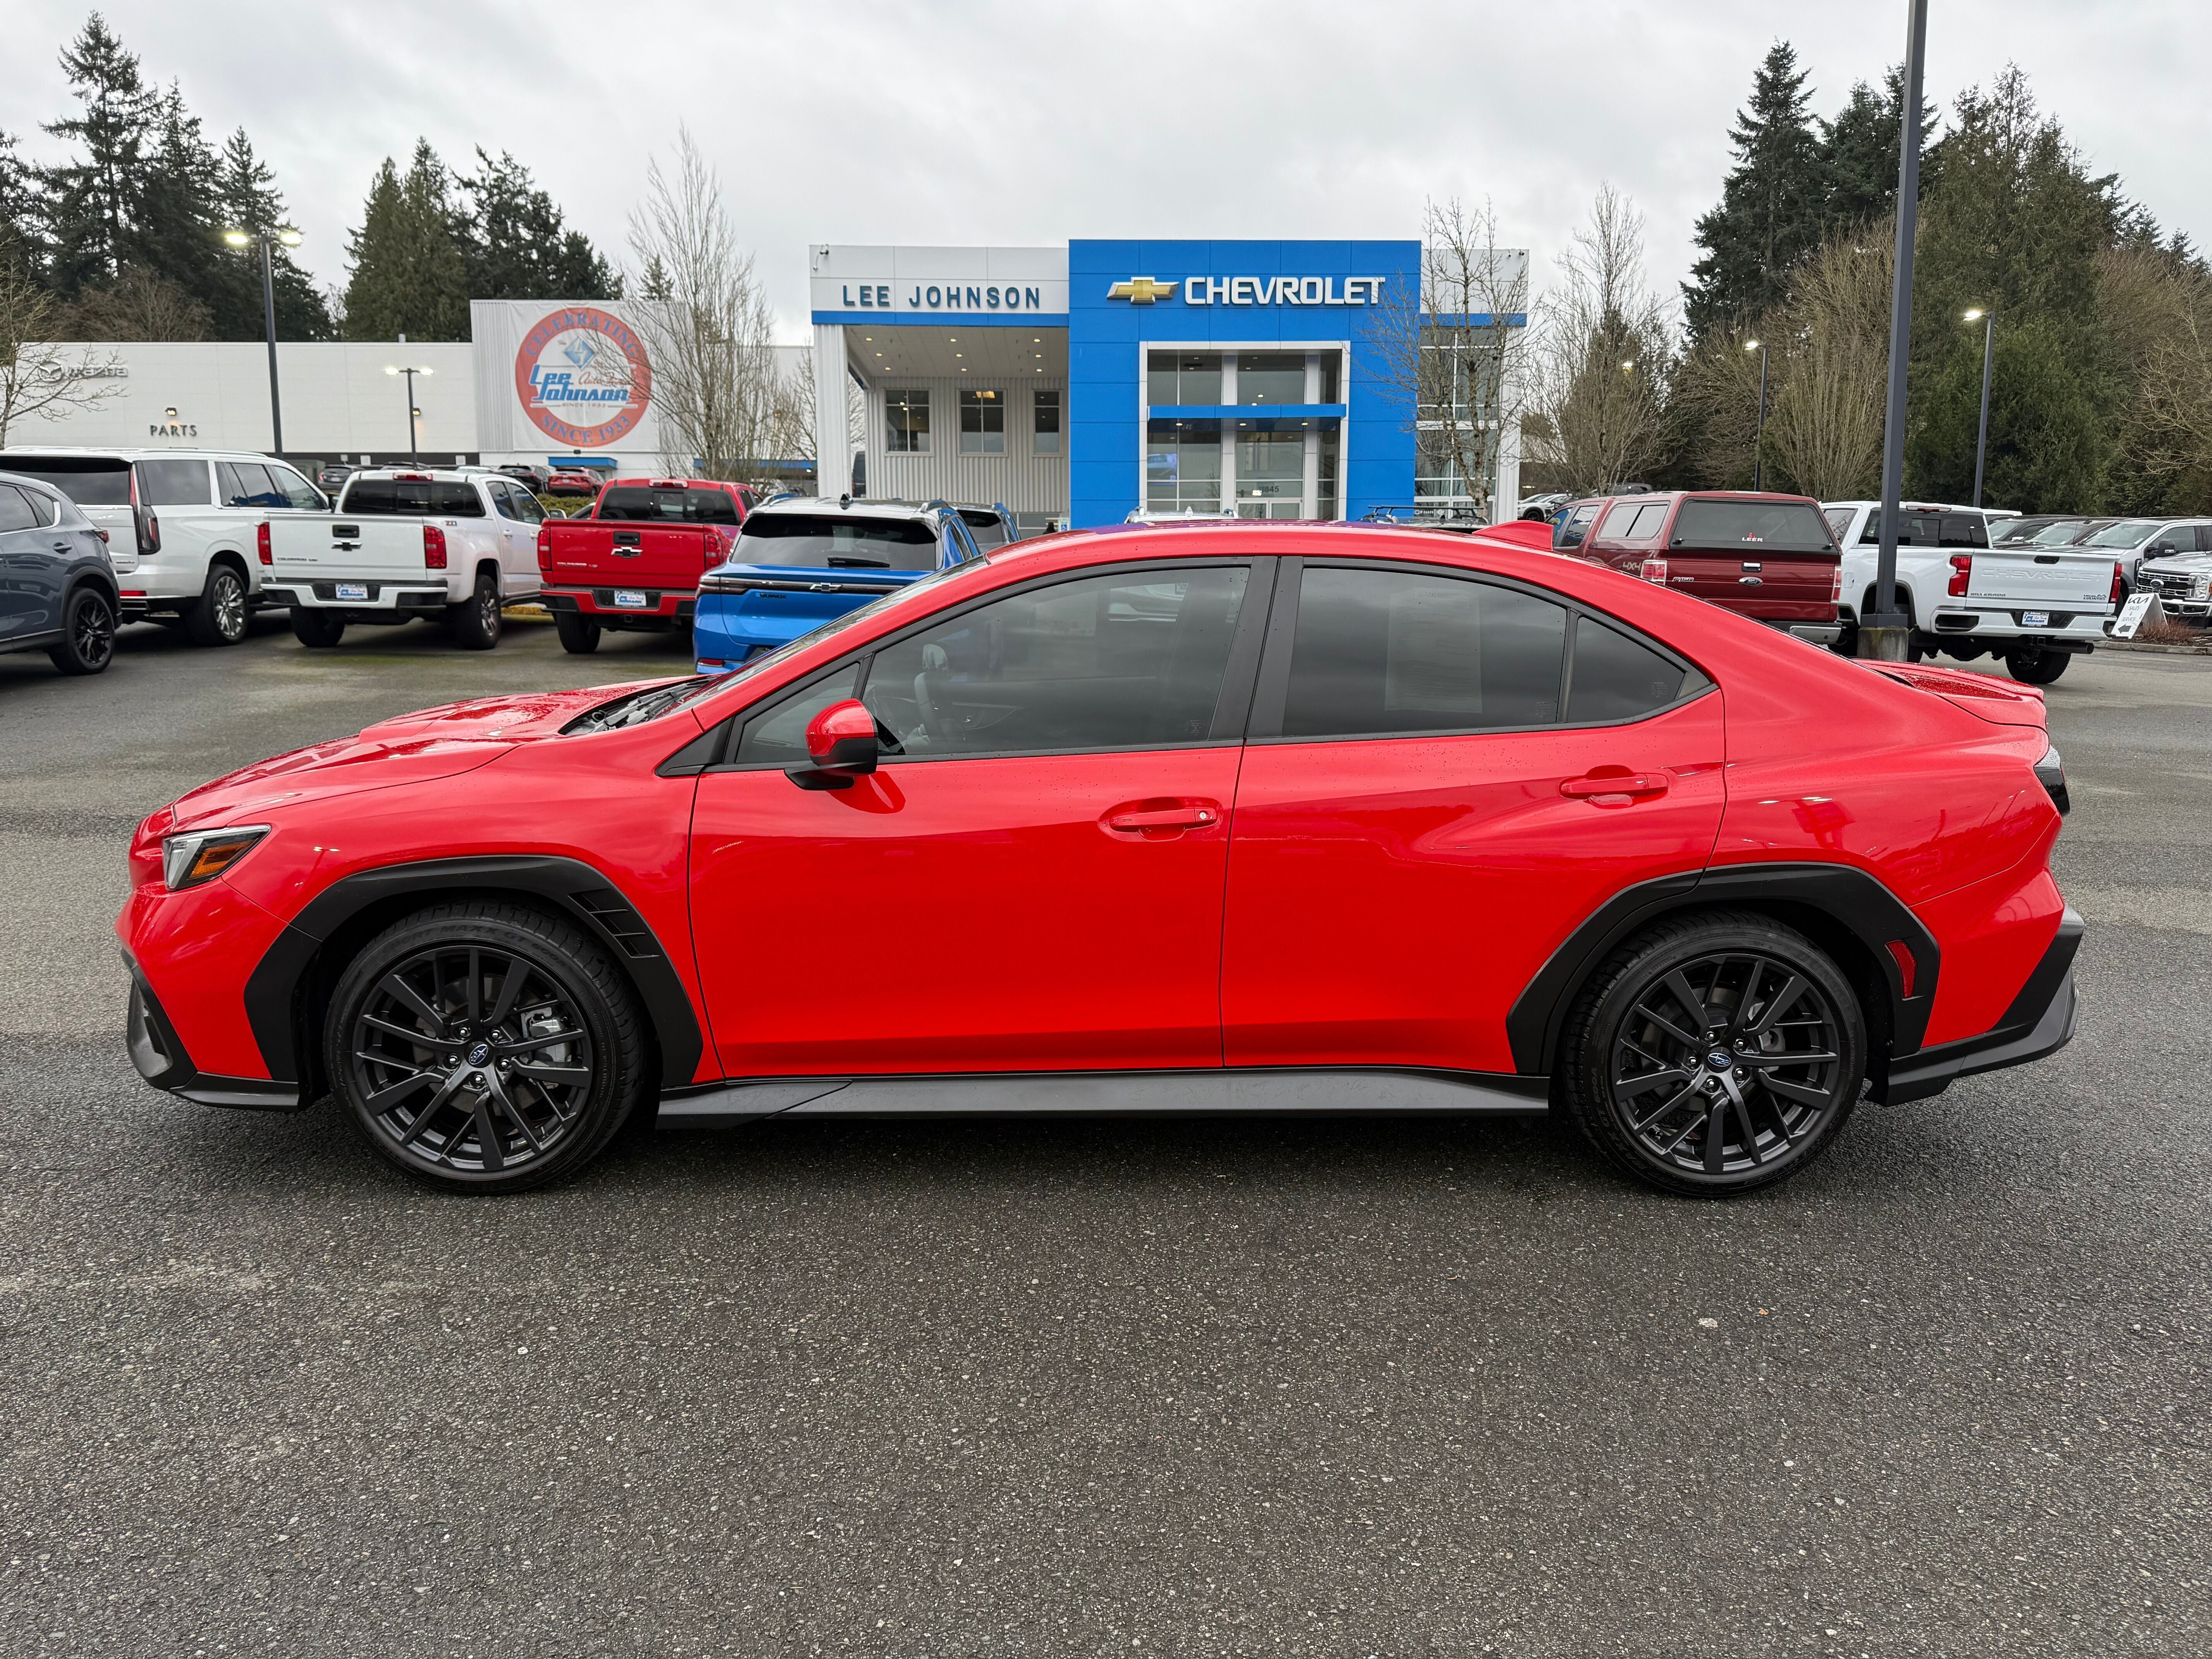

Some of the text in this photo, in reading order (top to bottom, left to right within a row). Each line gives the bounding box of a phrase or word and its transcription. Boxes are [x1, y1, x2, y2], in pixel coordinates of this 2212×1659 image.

[843, 285, 1040, 308] LEE JOHNSON
[1185, 277, 1386, 304] CHEVROLET
[526, 313, 640, 356] CELEBRATING
[530, 364, 574, 385] Lee
[532, 383, 630, 401] Johnson
[150, 424, 198, 436] PARTS
[541, 415, 630, 443] SINCE 1933
[1623, 562, 1641, 571] 4X4
[1981, 568, 2105, 581] CHEVROLET
[439, 924, 498, 935] MAXX
[503, 930, 527, 944] GT
